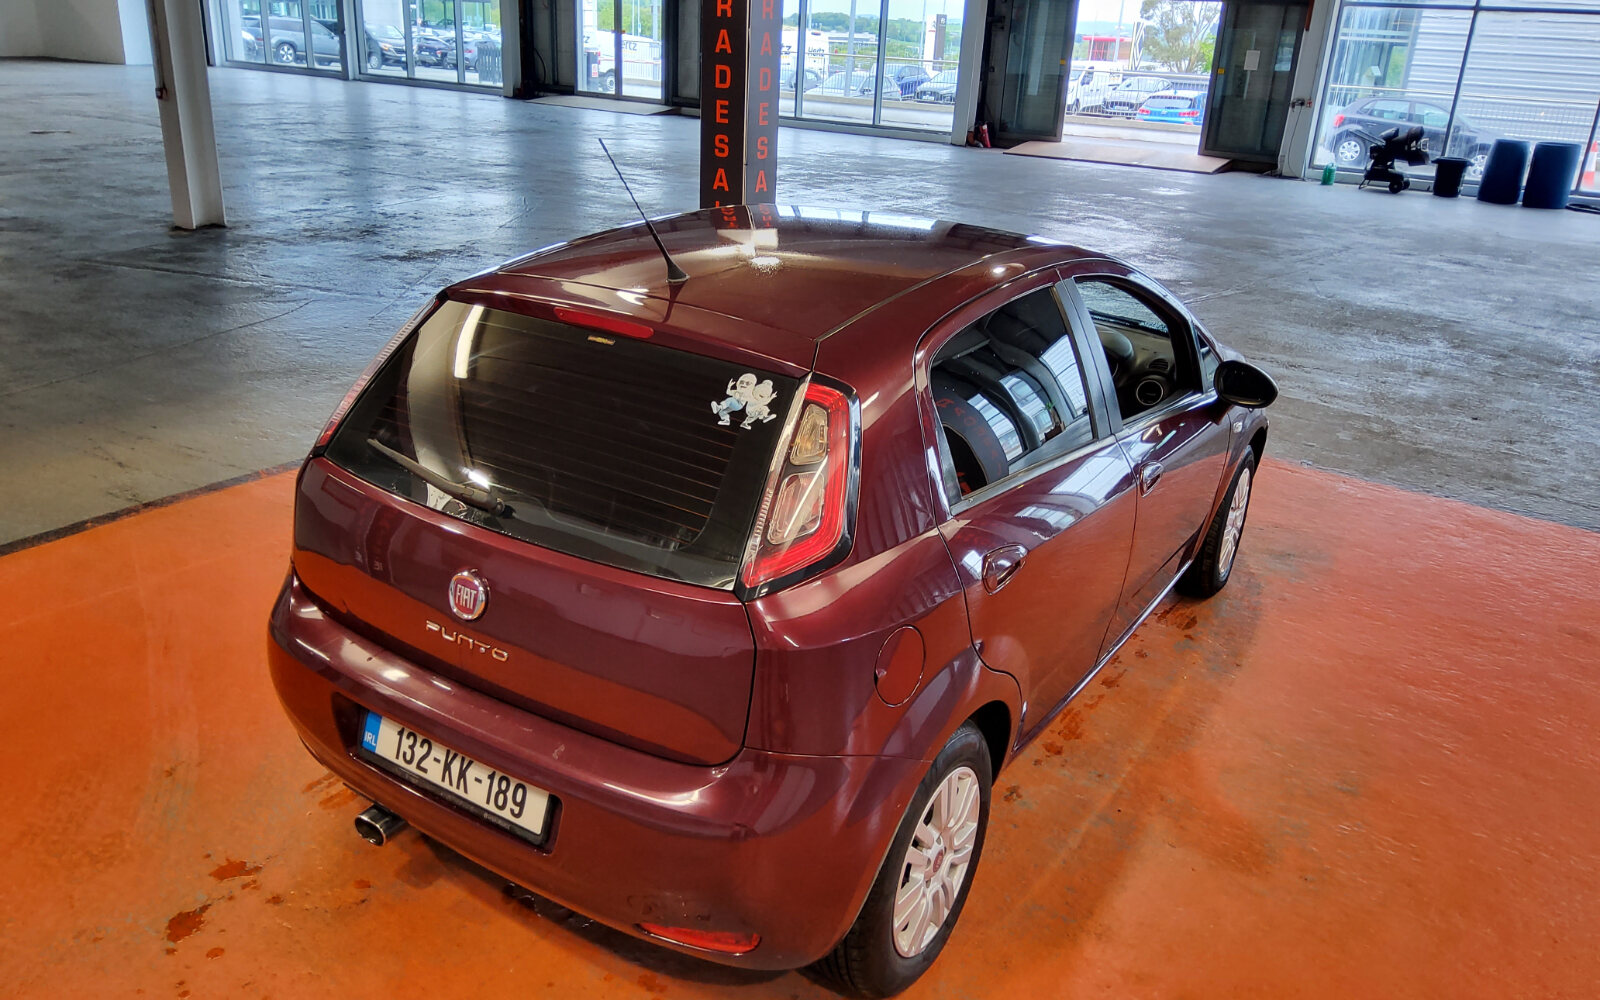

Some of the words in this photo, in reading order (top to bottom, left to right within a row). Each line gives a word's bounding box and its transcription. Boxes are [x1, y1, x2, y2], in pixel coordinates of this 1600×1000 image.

[456, 584, 477, 610] FIAT
[426, 620, 508, 661] PUNTO
[364, 731, 377, 746] IRL
[395, 727, 528, 819] 132-KK-189
